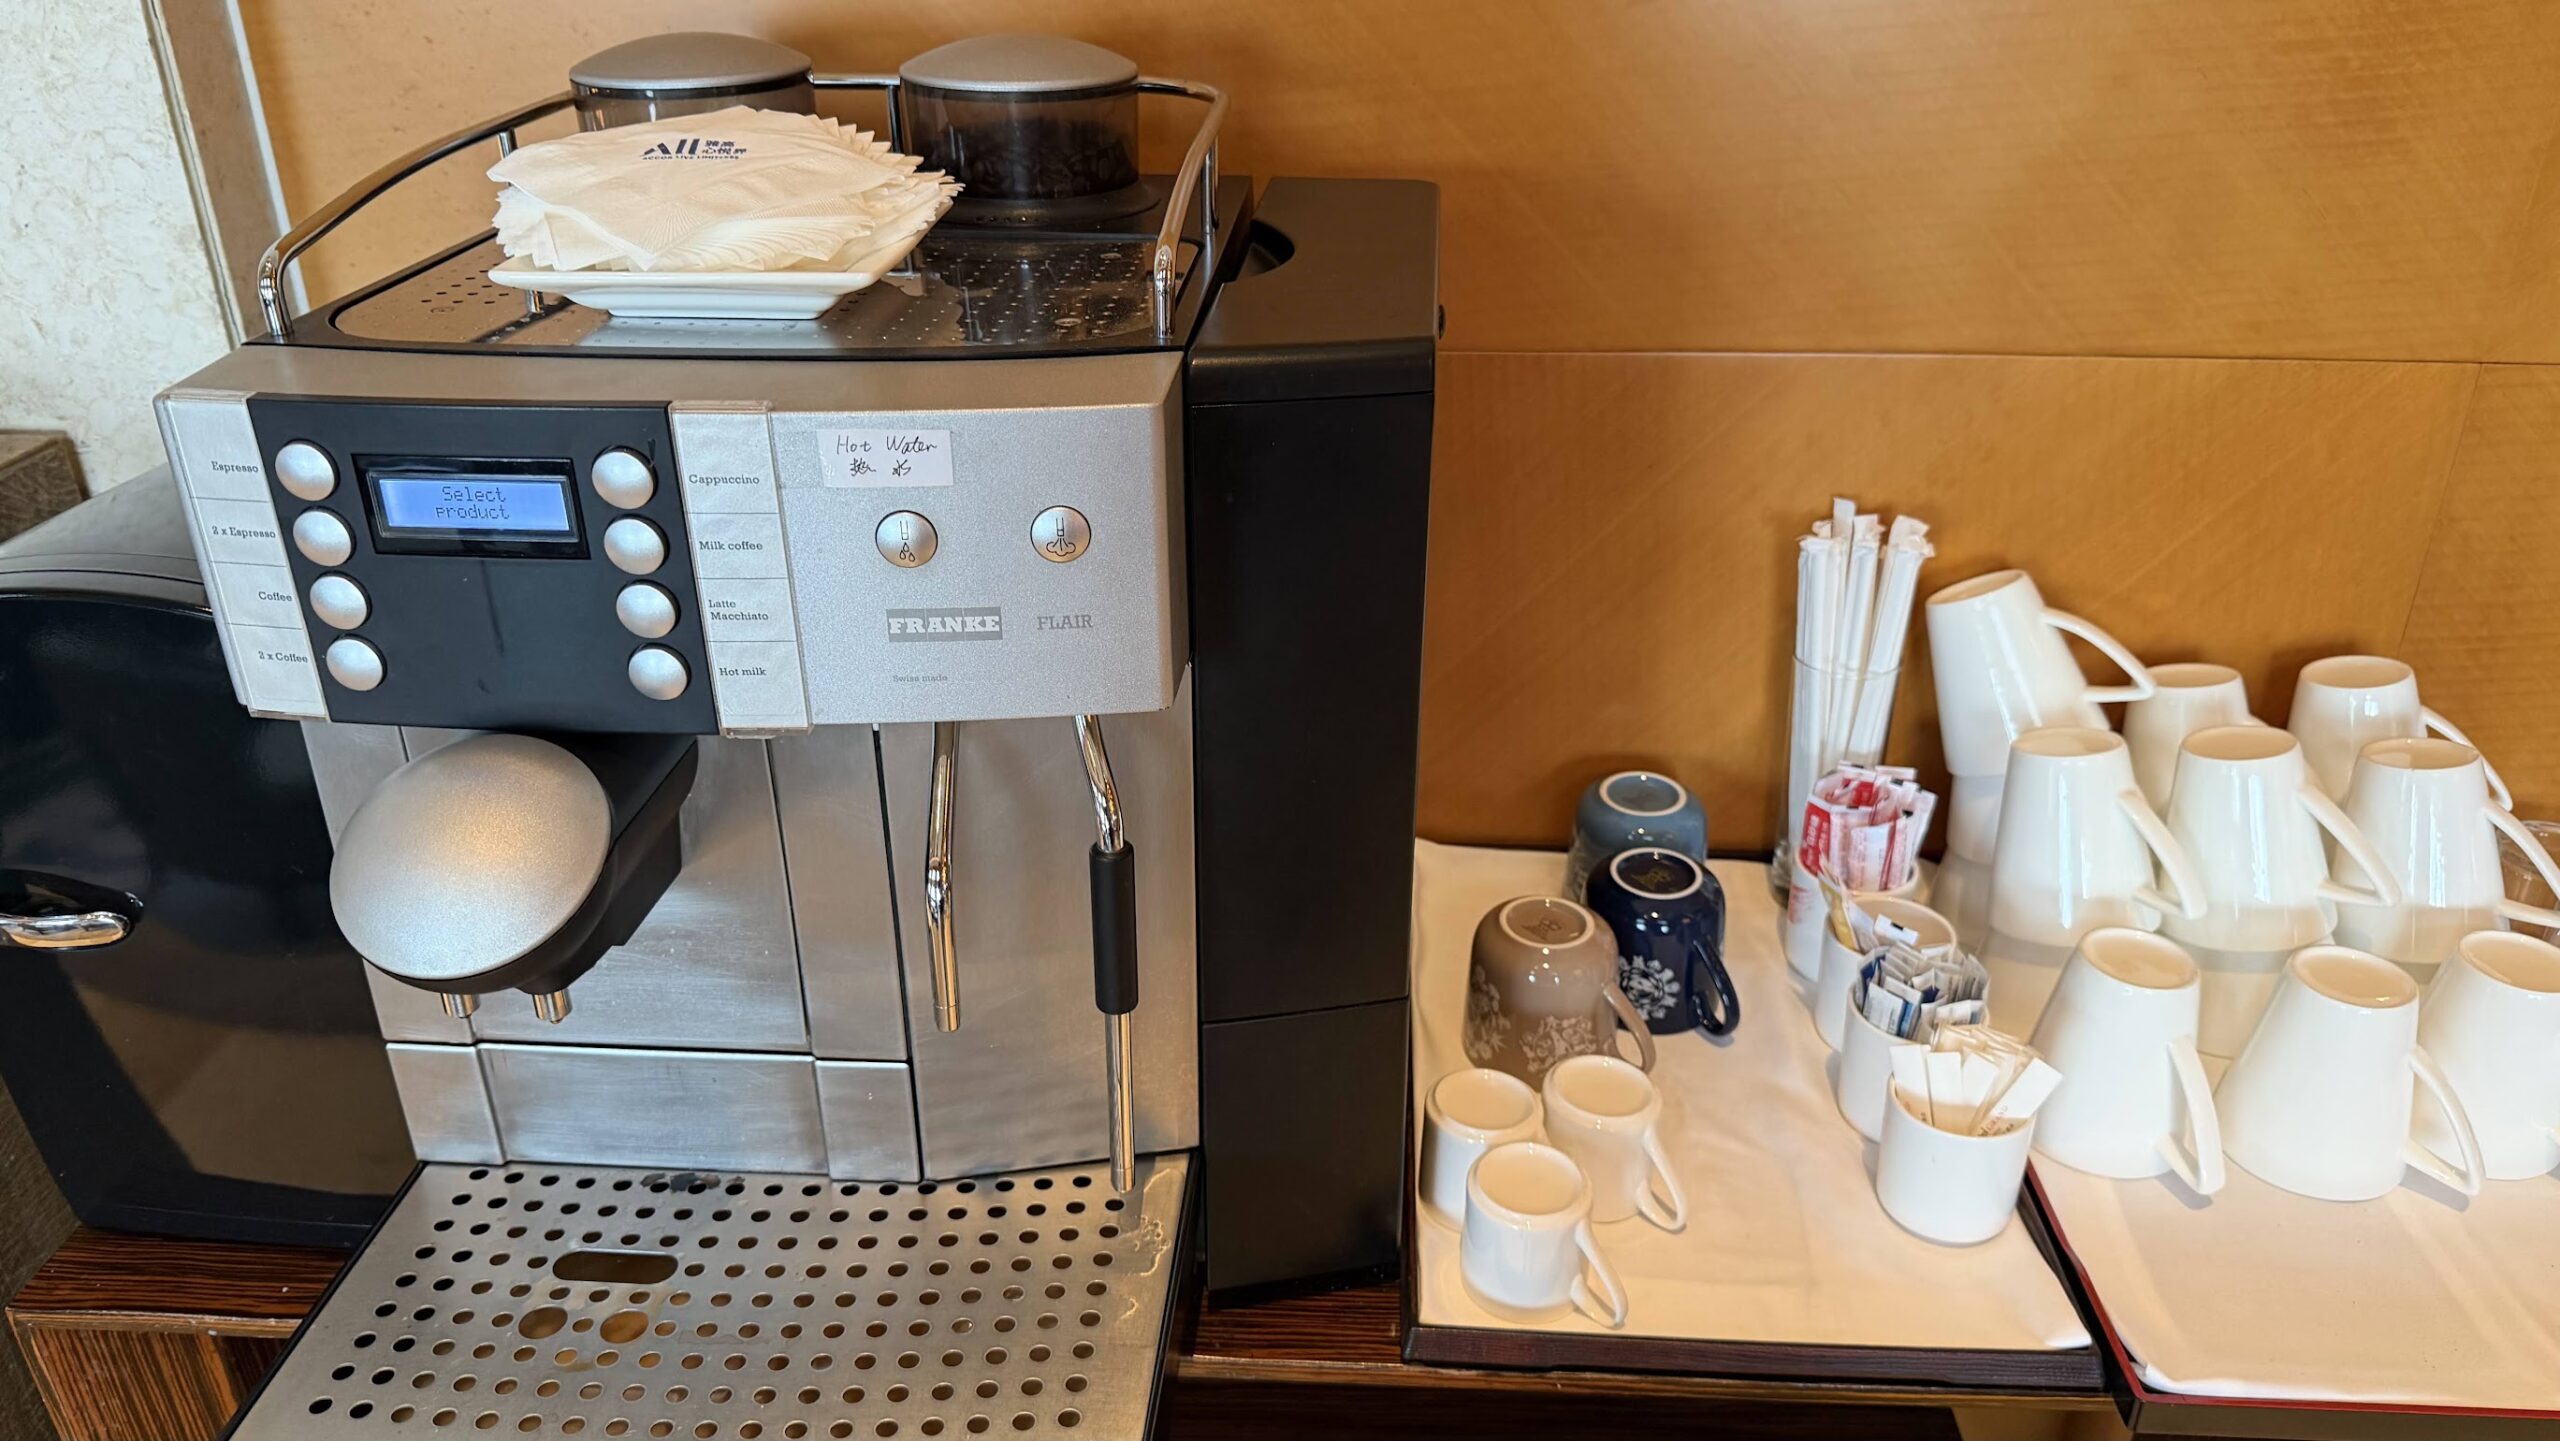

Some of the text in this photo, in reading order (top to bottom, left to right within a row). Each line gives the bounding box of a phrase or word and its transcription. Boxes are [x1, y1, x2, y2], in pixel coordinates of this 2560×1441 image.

[836, 434, 938, 455] Hot Water
[211, 460, 259, 474] Espresso
[688, 473, 760, 487] Cappuccino
[441, 485, 507, 503] Select
[212, 525, 219, 535] 2
[228, 526, 276, 539] Espresso
[698, 540, 764, 551] Milk coffee
[258, 591, 293, 602] Coffee
[708, 599, 736, 609] Latte
[710, 611, 769, 621] Macchiato
[1036, 613, 1094, 631] FLAIR
[888, 615, 1001, 635] FRANKE
[258, 650, 308, 663] 2 x Coffee
[719, 666, 767, 677] Hot milk
[892, 674, 948, 683] Swiss made
